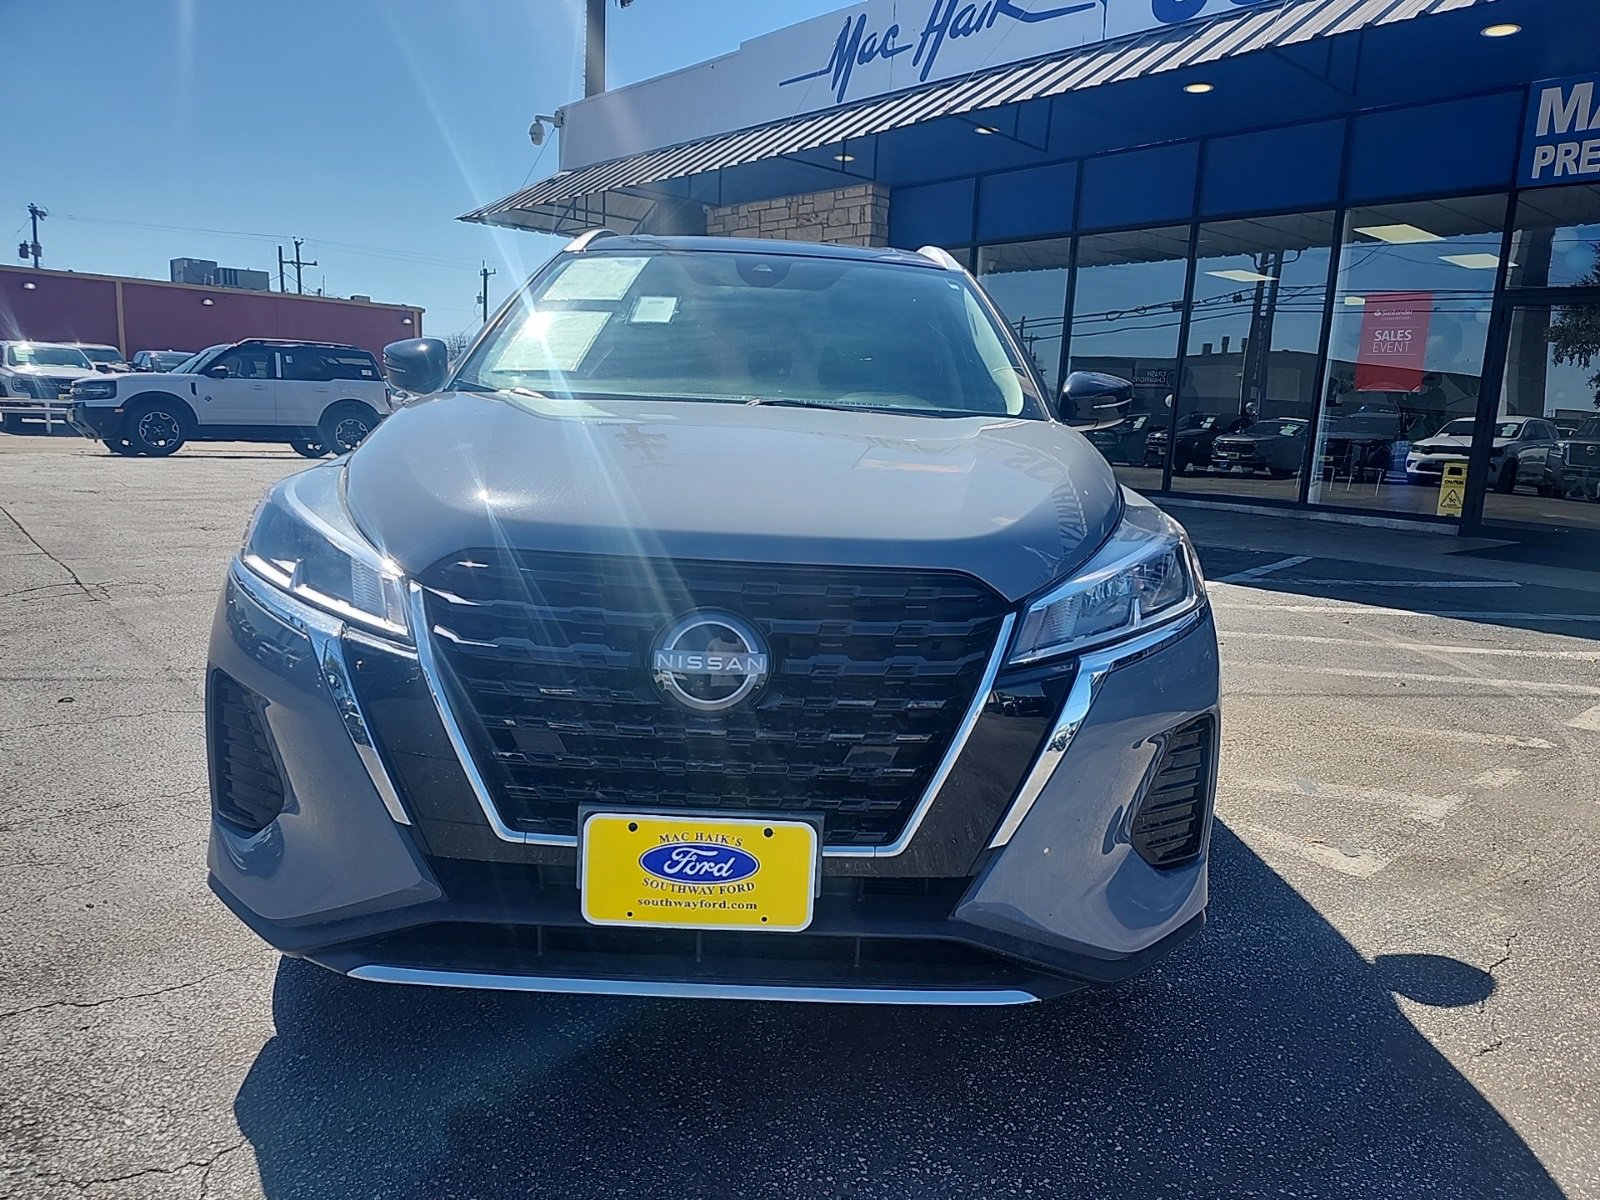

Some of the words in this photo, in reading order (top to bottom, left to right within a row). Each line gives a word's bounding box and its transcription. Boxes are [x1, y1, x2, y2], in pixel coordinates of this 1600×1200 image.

[779, 13, 913, 103] Mac
[1531, 139, 1600, 179] PRE
[1374, 329, 1412, 341] SALES
[1372, 341, 1411, 353] EVENT
[657, 653, 763, 671] NISSAN
[659, 831, 689, 844] MAC
[695, 832, 744, 847] HAIK'S
[663, 847, 734, 878] Ford
[642, 877, 717, 896] SOUTHWAY
[719, 881, 756, 895] FORD
[637, 898, 758, 911] southwayford.com
